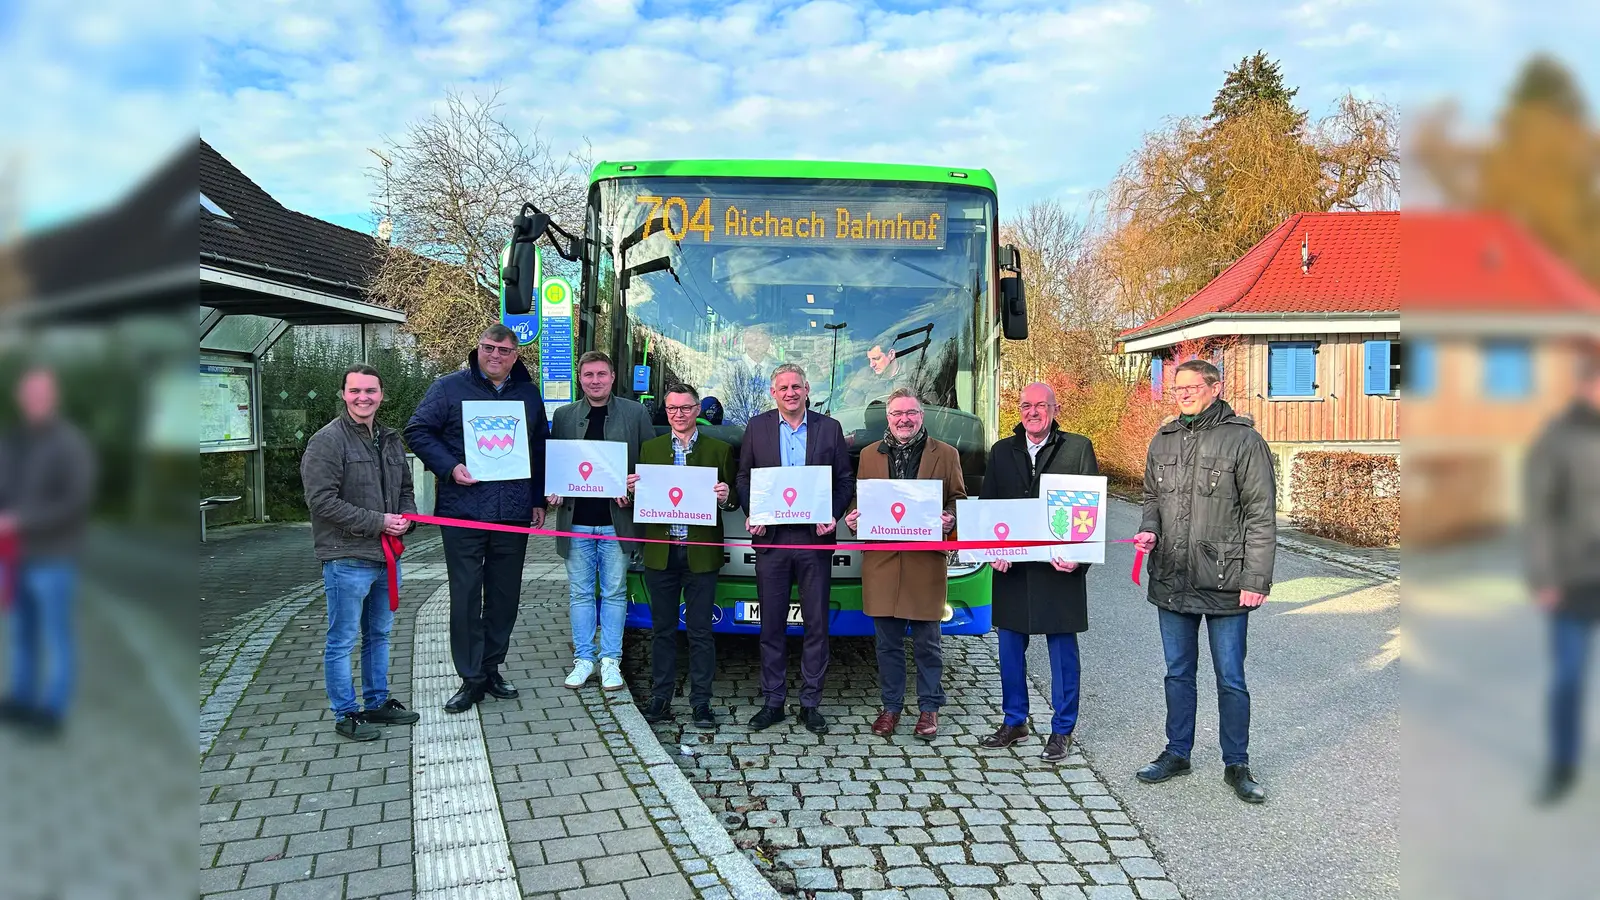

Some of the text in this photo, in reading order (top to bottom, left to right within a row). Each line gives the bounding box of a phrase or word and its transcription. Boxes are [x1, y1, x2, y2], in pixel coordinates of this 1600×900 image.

[637, 196, 940, 242] 704 Aichach Bahnhof
[568, 483, 604, 493] Dachau
[639, 508, 713, 521] Schwabhausen
[774, 509, 811, 519] Erdweg
[870, 525, 933, 536] Altomünster
